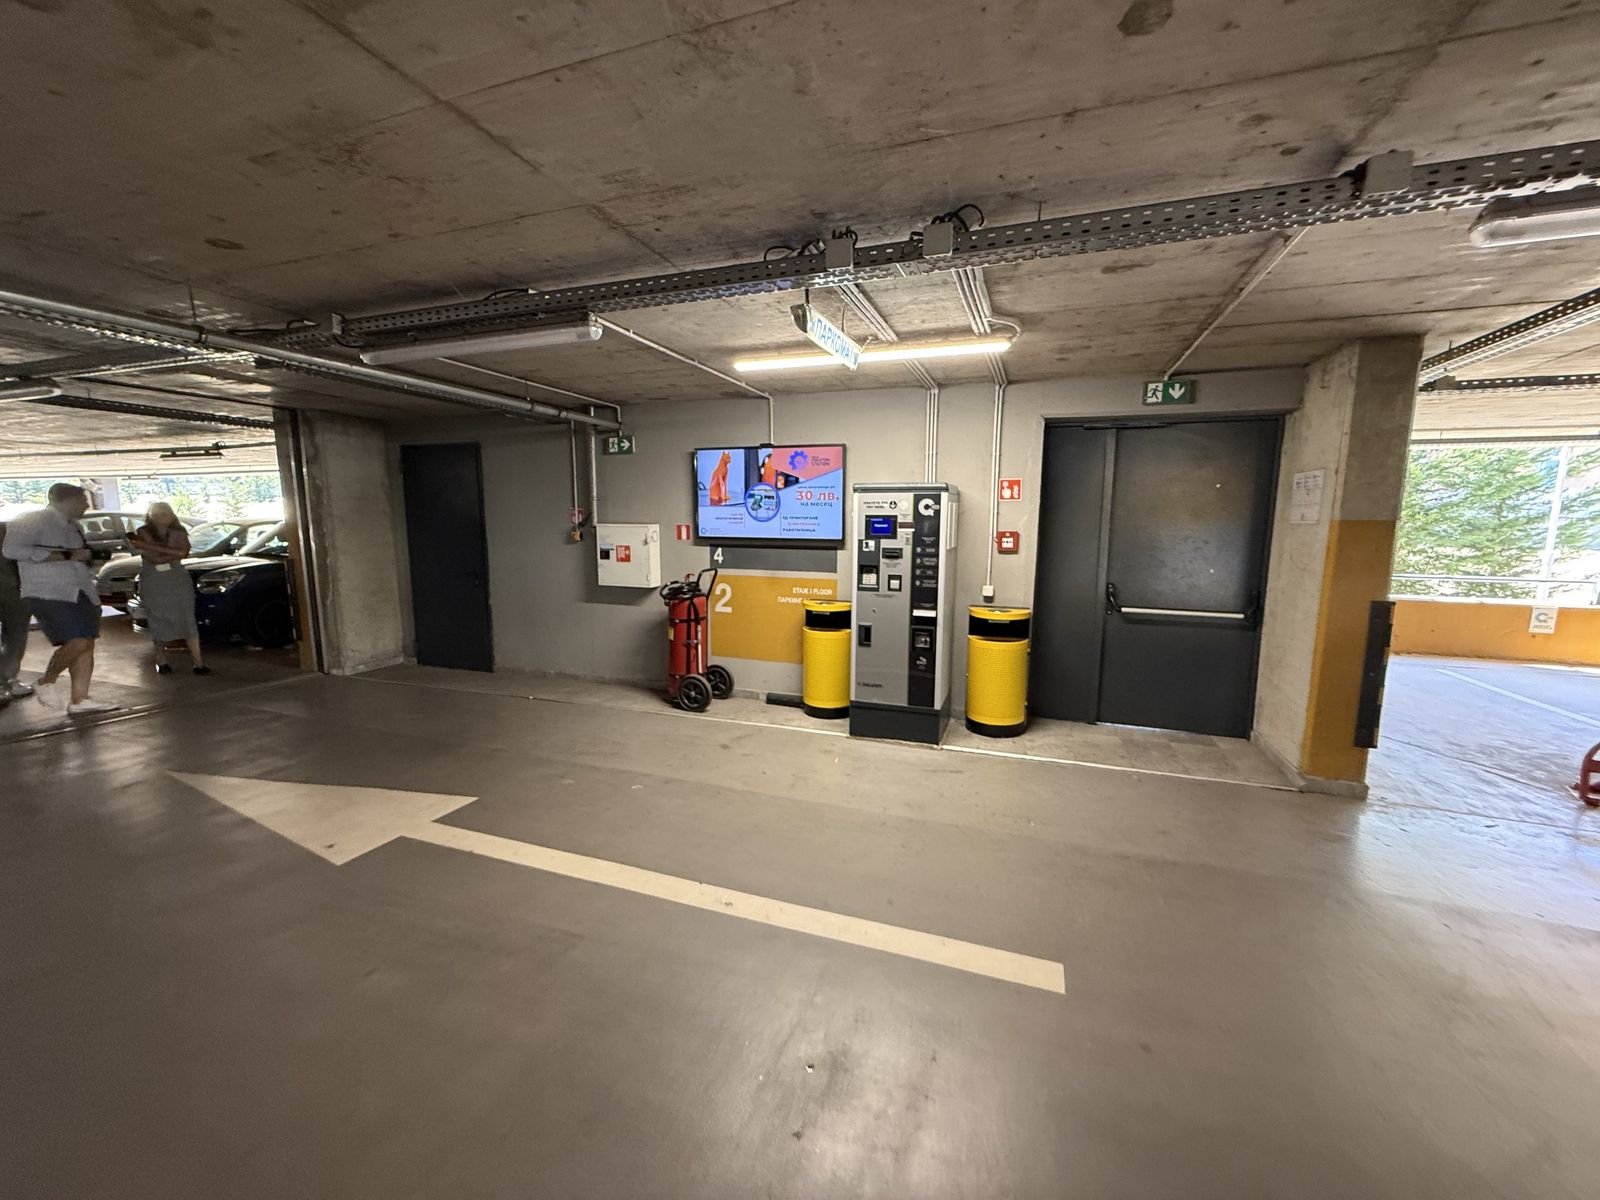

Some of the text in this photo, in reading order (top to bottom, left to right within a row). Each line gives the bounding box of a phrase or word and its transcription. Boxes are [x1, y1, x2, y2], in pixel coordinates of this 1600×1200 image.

[815, 318, 855, 363] ПАРКОМАТ
[796, 490, 813, 501] 30
[713, 547, 724, 564] 4
[715, 582, 732, 613] 2
